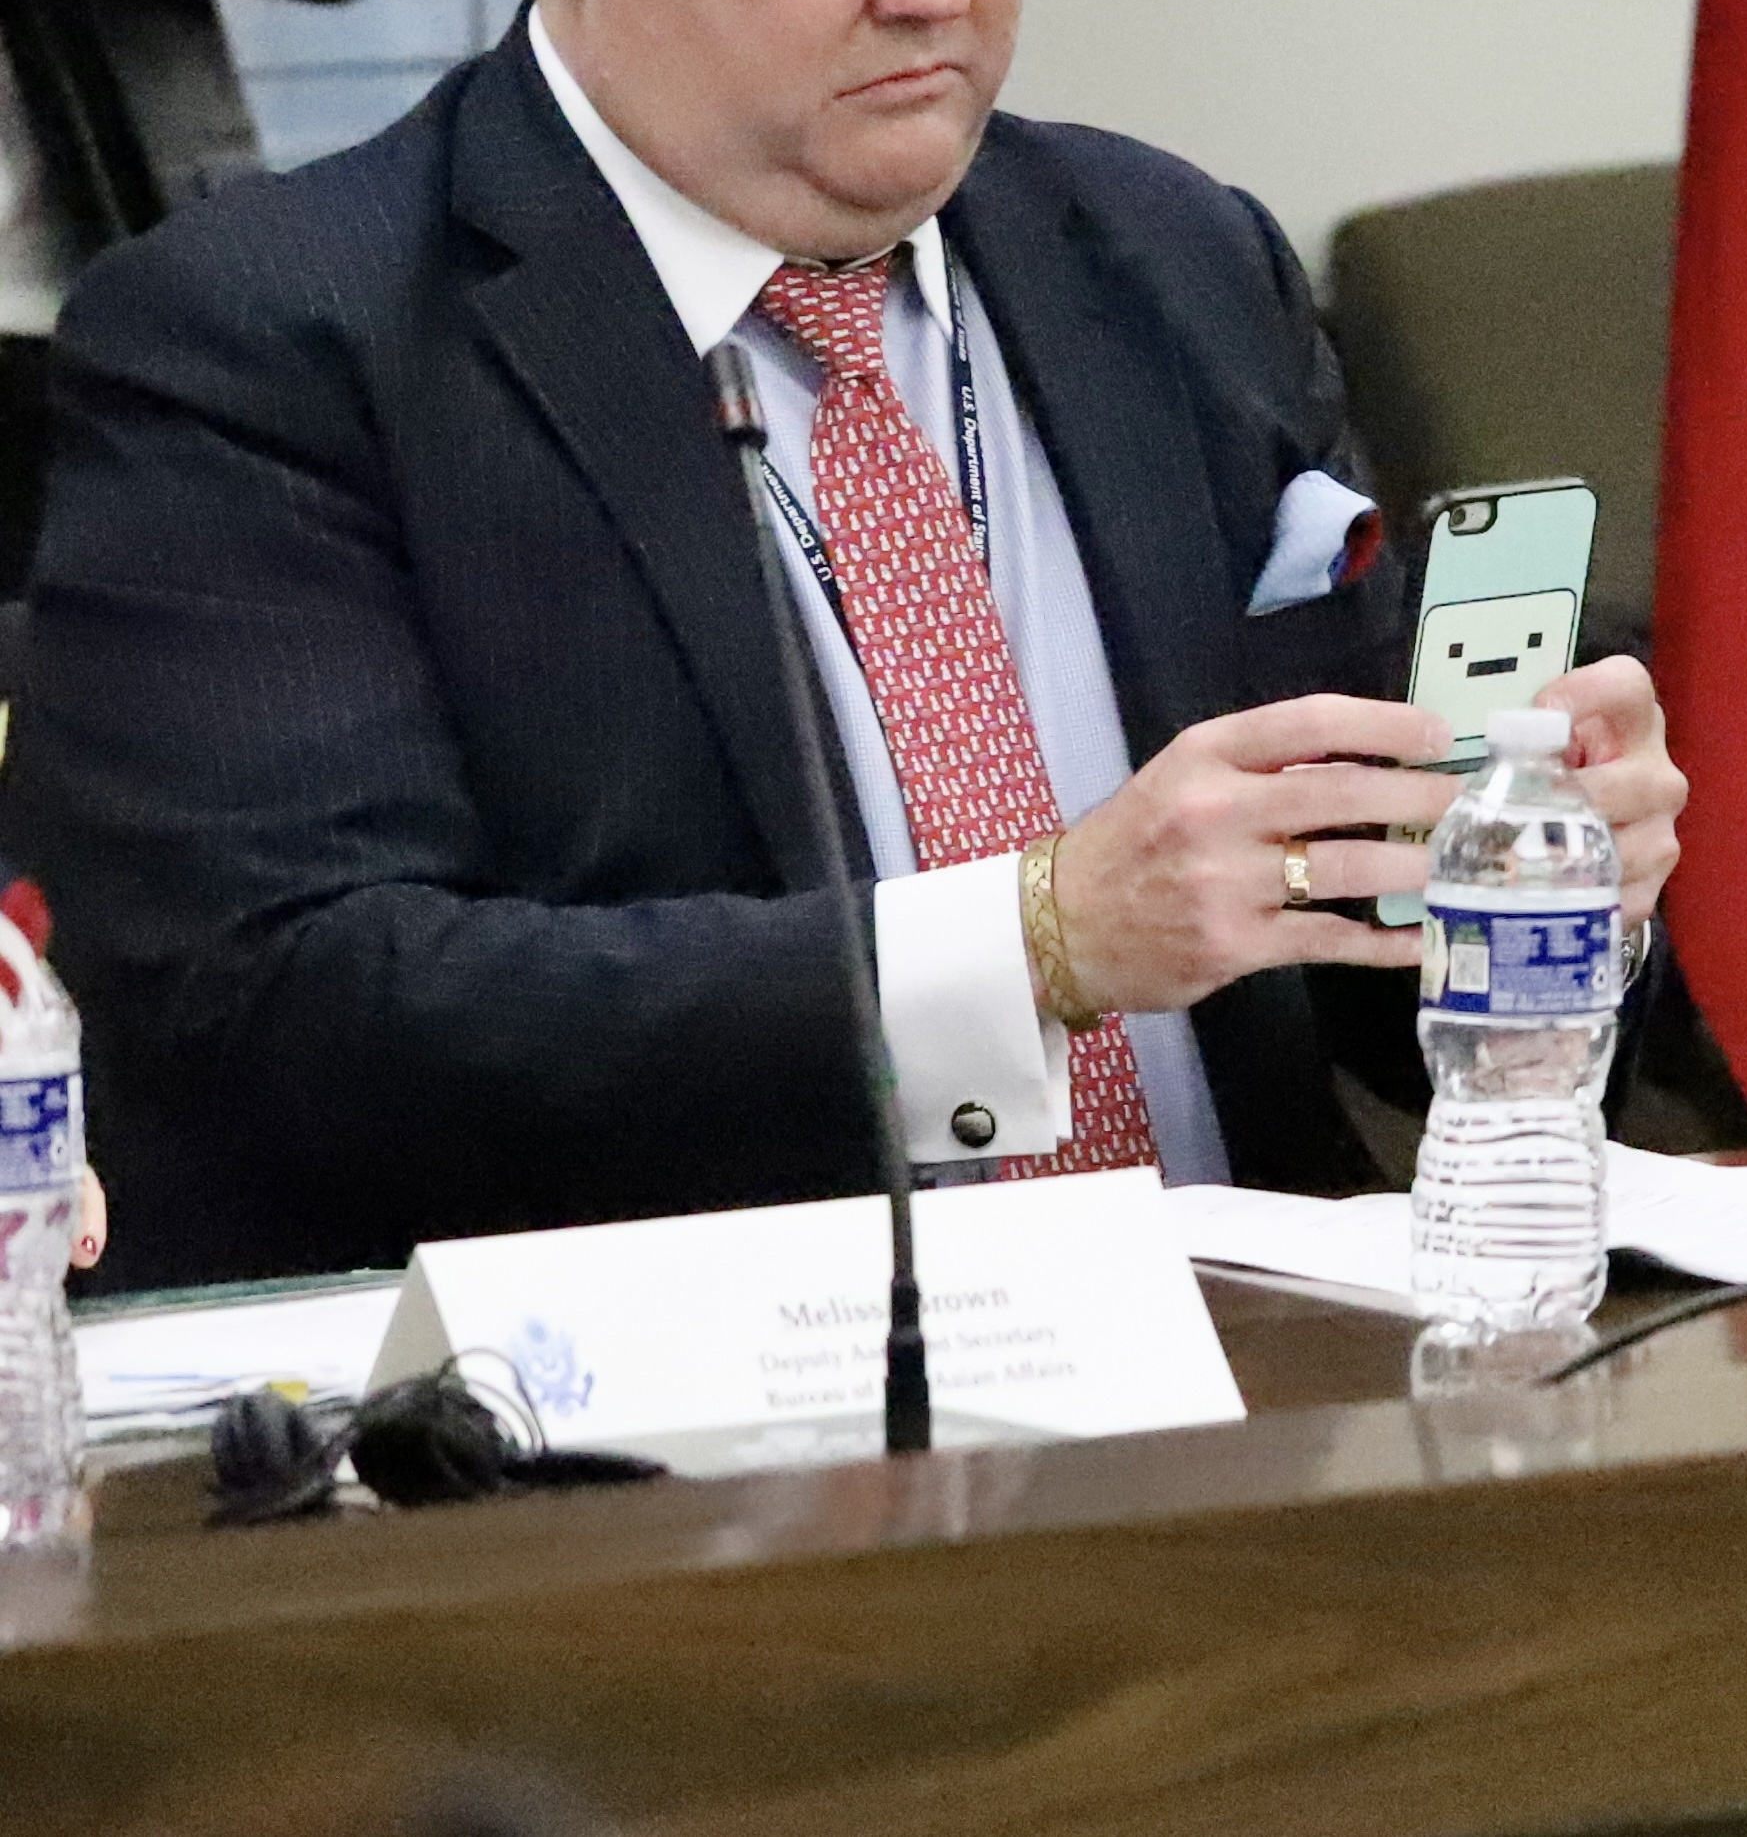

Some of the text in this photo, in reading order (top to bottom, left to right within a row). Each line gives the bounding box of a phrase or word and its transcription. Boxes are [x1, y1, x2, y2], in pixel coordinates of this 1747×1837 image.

[961, 385, 976, 413] U.S.
[961, 417, 982, 501] Department
[972, 503, 987, 523] of
[810, 549, 833, 582] U.S.
[777, 1293, 891, 1331] Meliss
